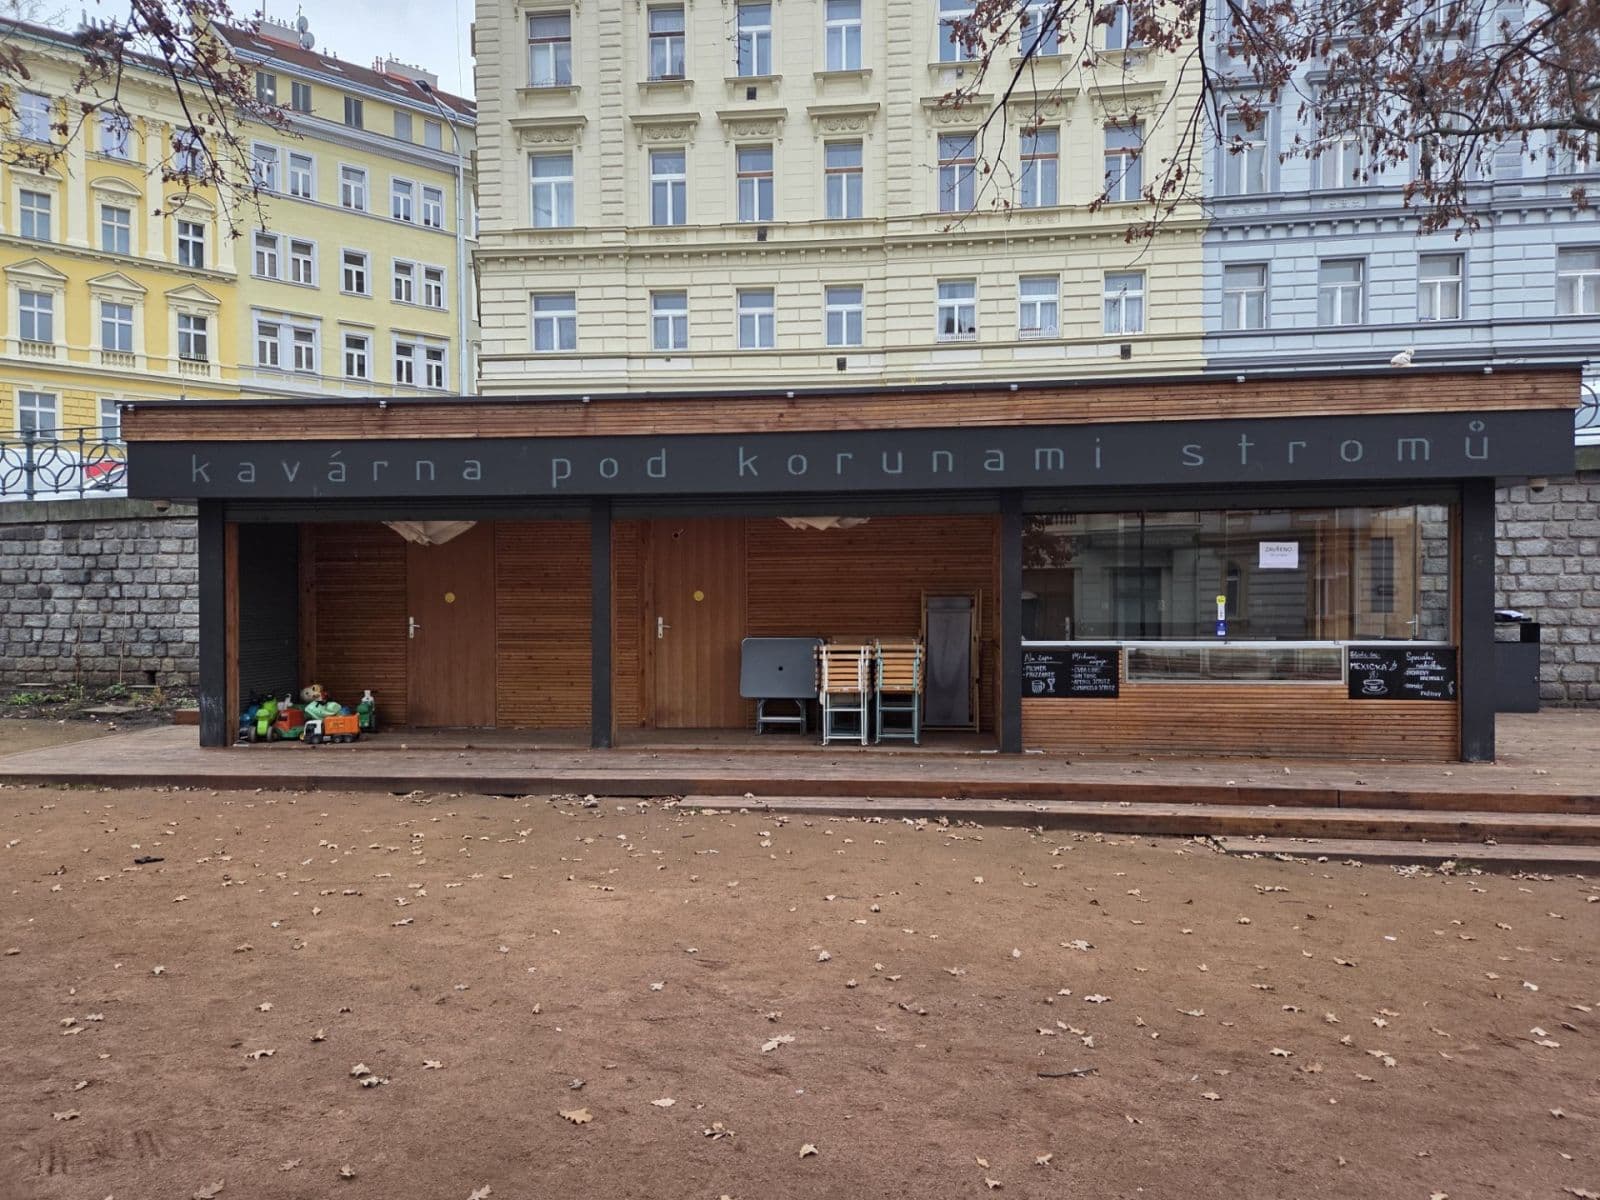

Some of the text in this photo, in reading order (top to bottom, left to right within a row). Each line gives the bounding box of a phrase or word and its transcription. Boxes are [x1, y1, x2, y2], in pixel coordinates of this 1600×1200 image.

[192, 420, 1489, 488] kavárna pod korunami stromů
